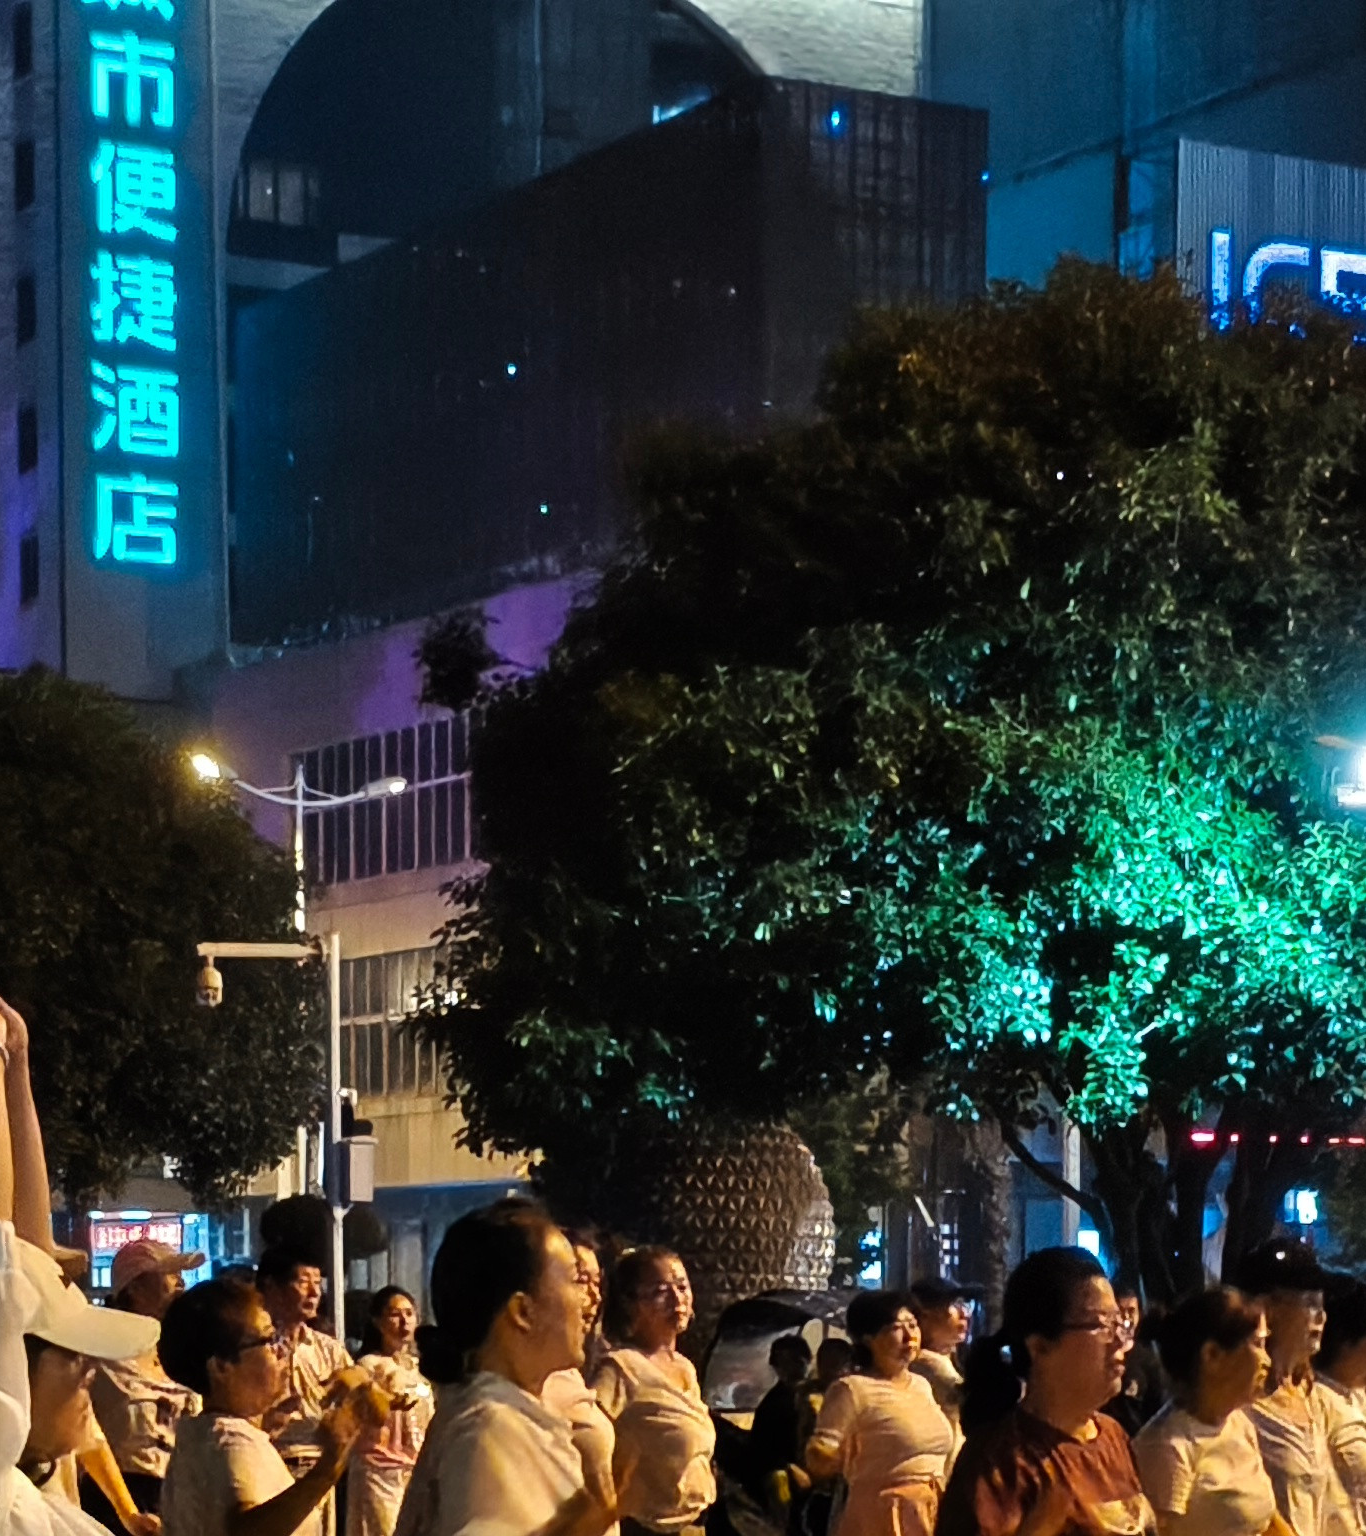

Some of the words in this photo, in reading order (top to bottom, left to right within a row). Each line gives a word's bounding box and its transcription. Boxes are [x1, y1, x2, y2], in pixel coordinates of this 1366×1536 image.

[82, 0, 180, 566] 市便捷酒店
